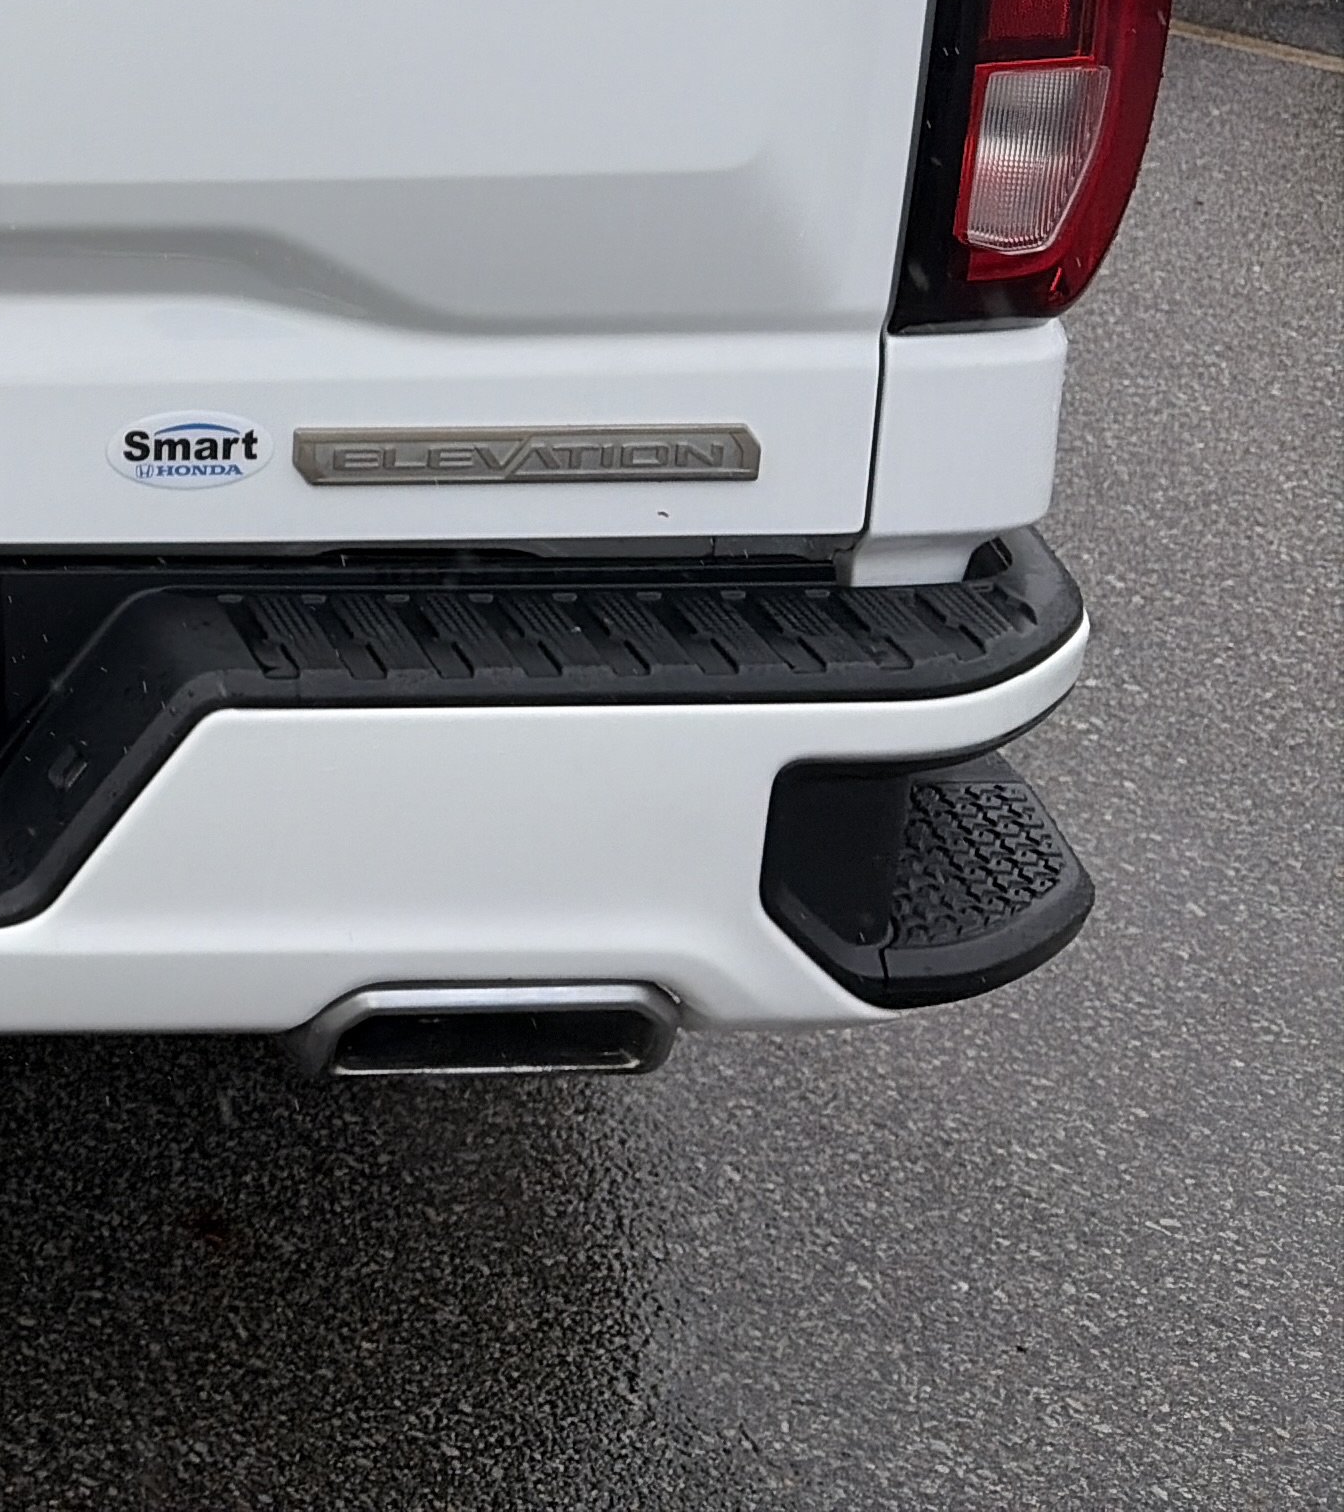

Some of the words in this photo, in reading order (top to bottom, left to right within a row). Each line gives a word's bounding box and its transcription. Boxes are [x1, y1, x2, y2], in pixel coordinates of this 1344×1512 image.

[123, 429, 258, 462] Smart
[333, 440, 725, 472] ELEVATION
[156, 464, 243, 477] HONDA
